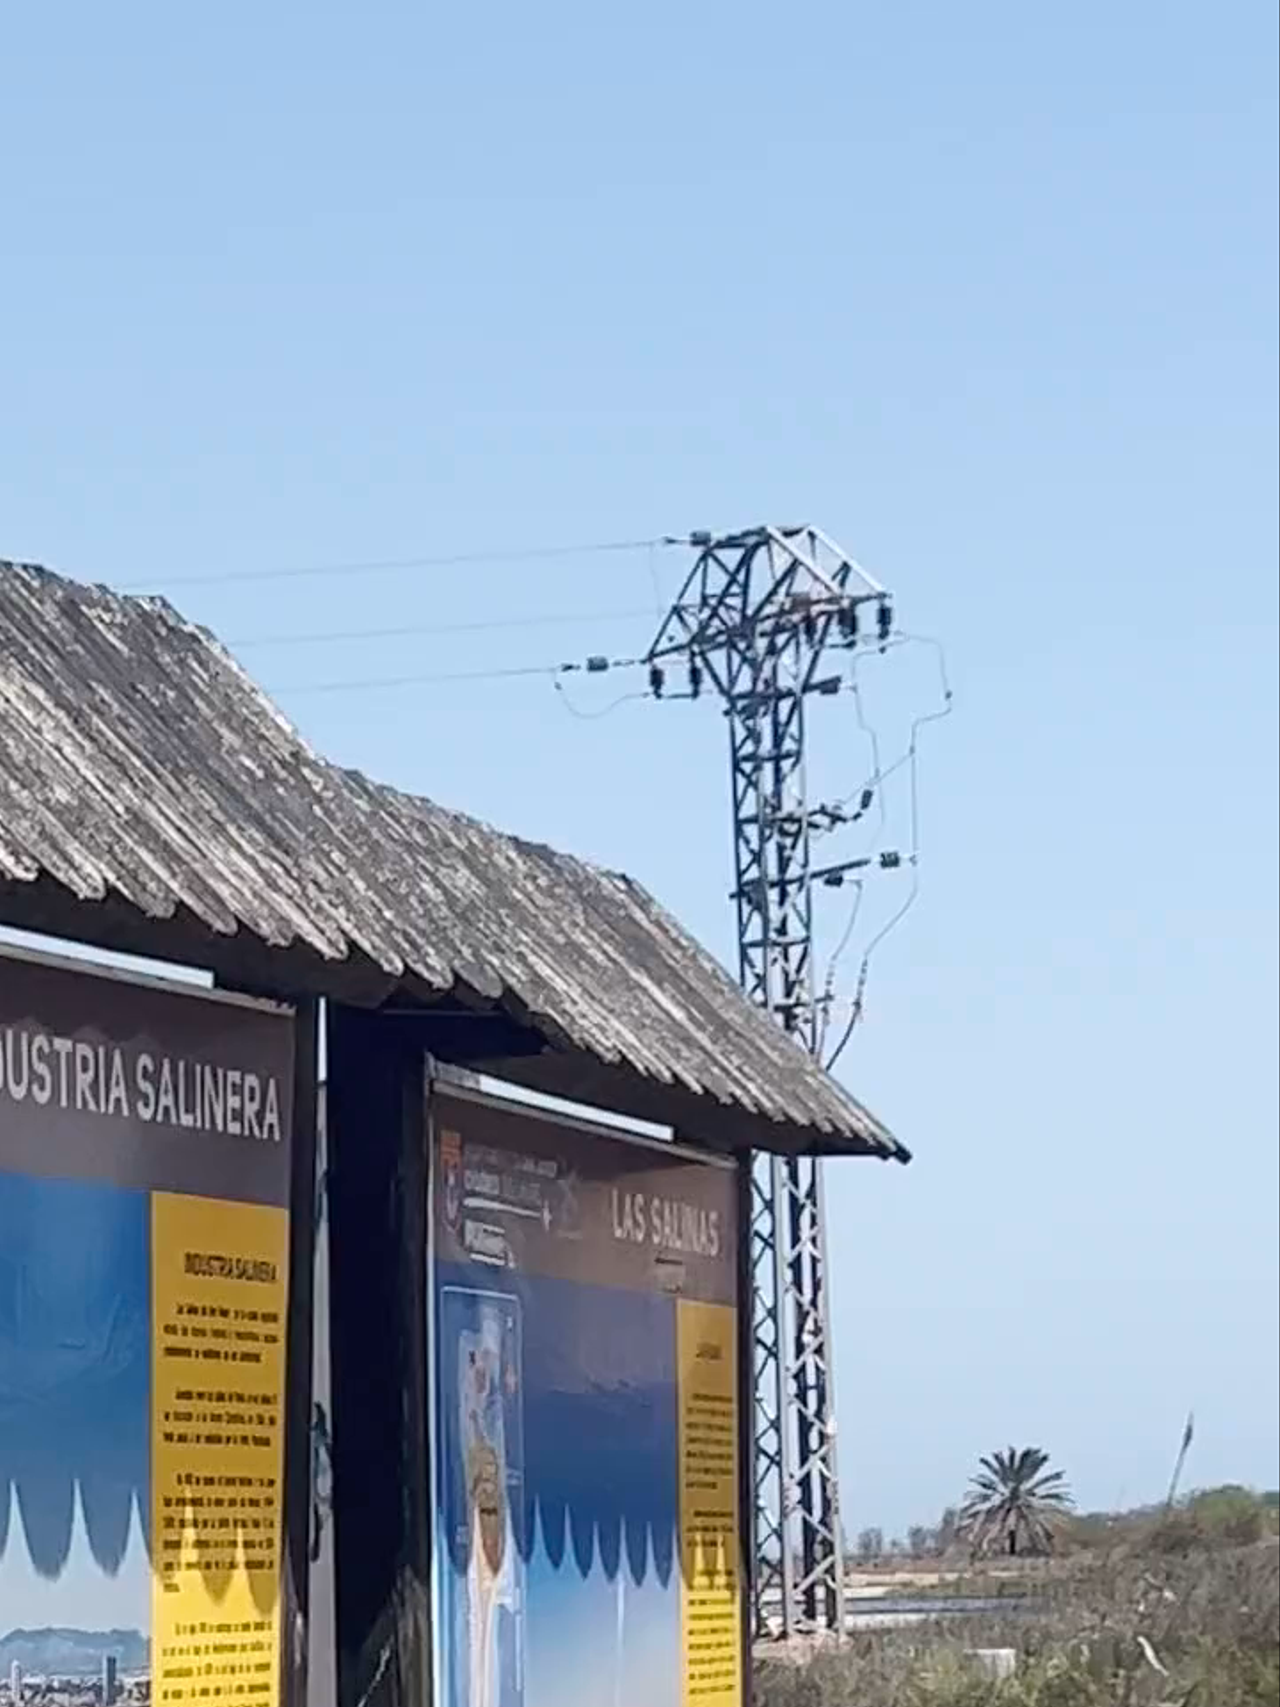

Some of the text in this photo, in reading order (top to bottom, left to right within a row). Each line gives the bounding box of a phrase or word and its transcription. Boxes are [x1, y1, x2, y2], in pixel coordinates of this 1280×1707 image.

[137, 1054, 279, 1141] SALINERA
[613, 1188, 719, 1257] LAS SALINAS
